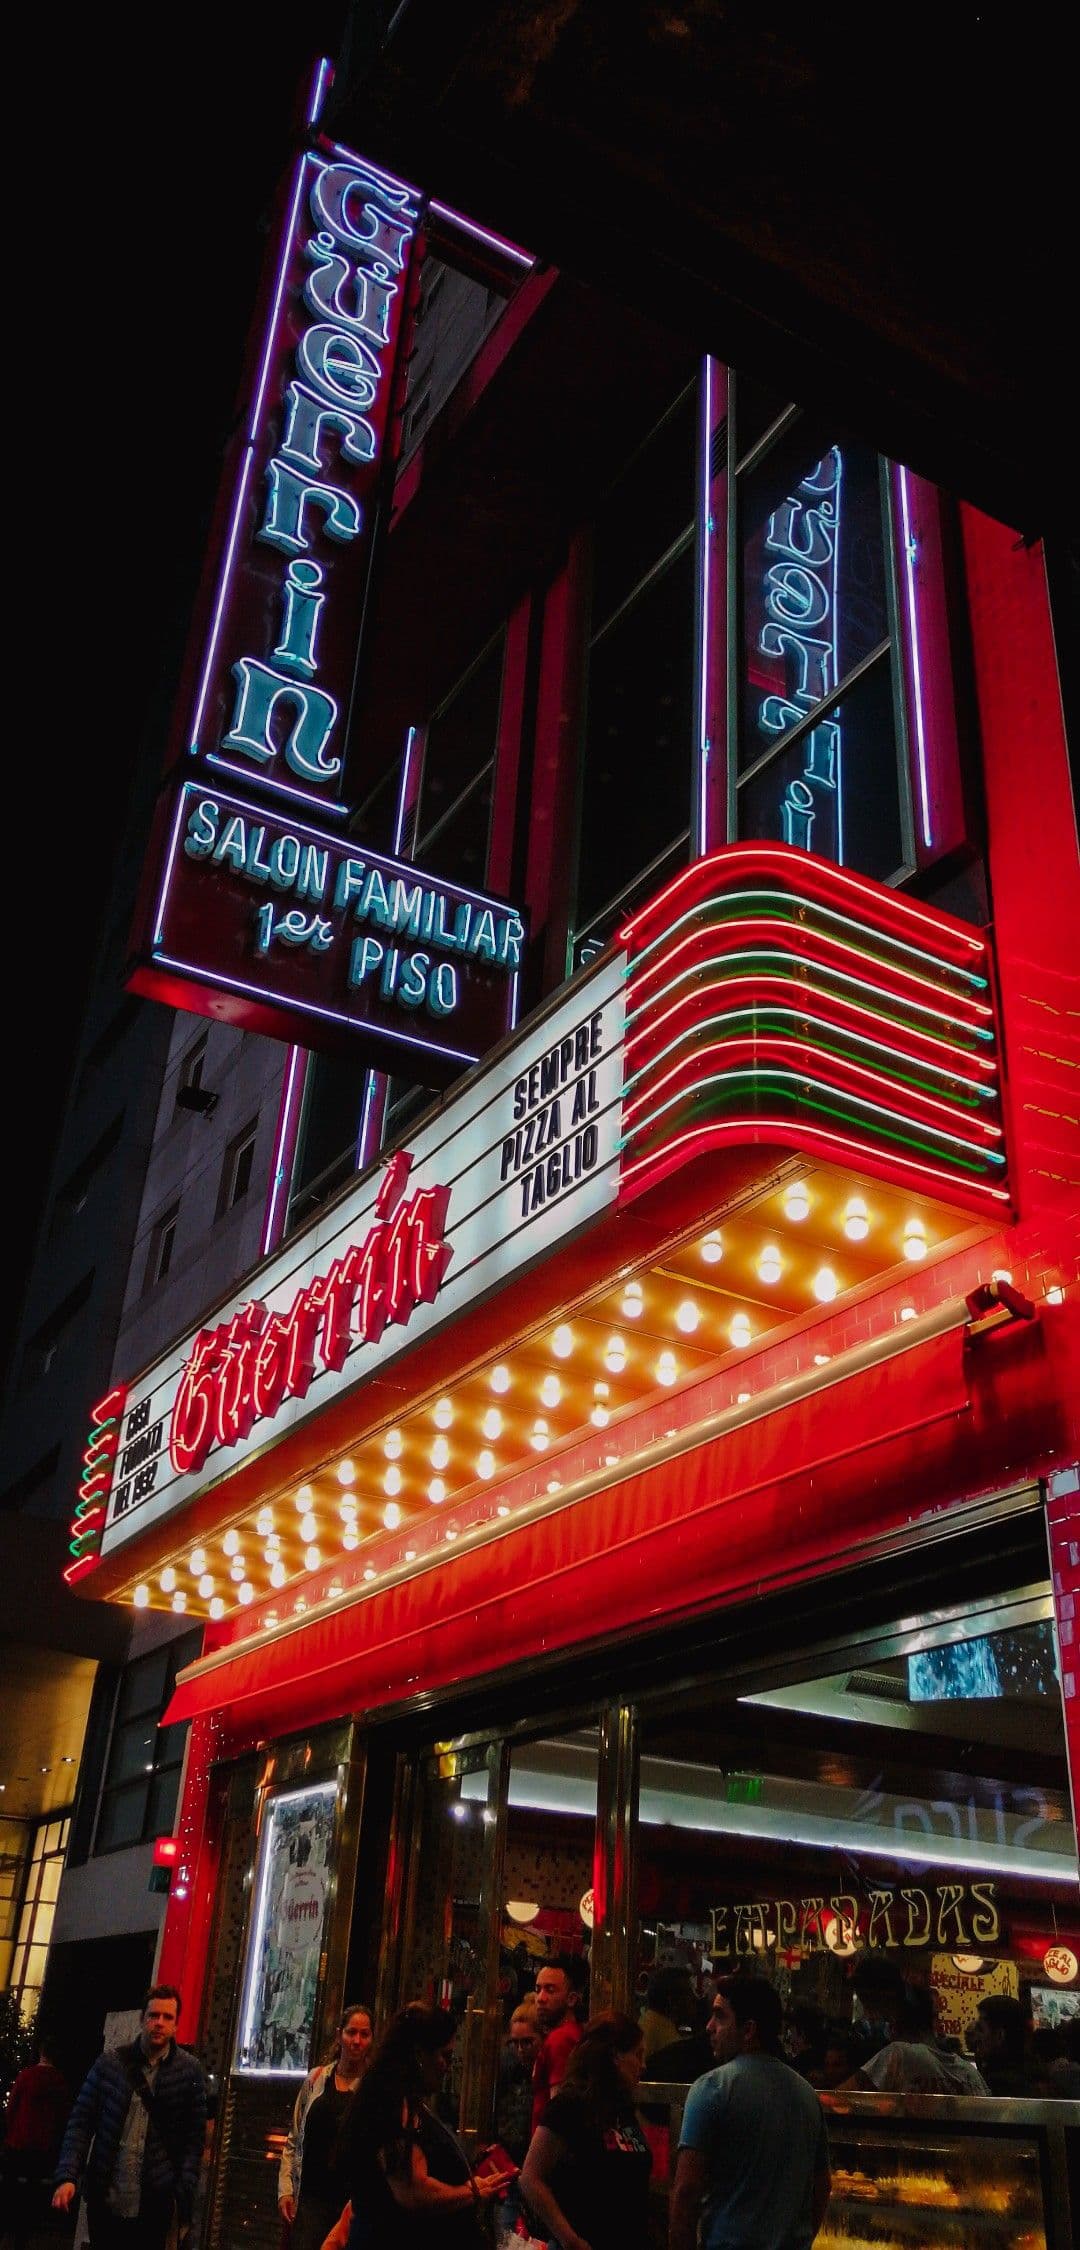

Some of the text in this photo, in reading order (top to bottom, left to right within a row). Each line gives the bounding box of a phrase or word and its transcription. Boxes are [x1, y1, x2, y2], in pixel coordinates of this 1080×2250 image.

[186, 800, 525, 967] SALON FAMILIAR
[257, 902, 334, 956] 1er
[350, 936, 458, 1018] PISO
[513, 1011, 603, 1121] SEMPRE
[500, 1070, 600, 1182] PIZZA AL
[520, 1123, 599, 1218] TAGLIO
[708, 1882, 1001, 1958] EMPANADAS
